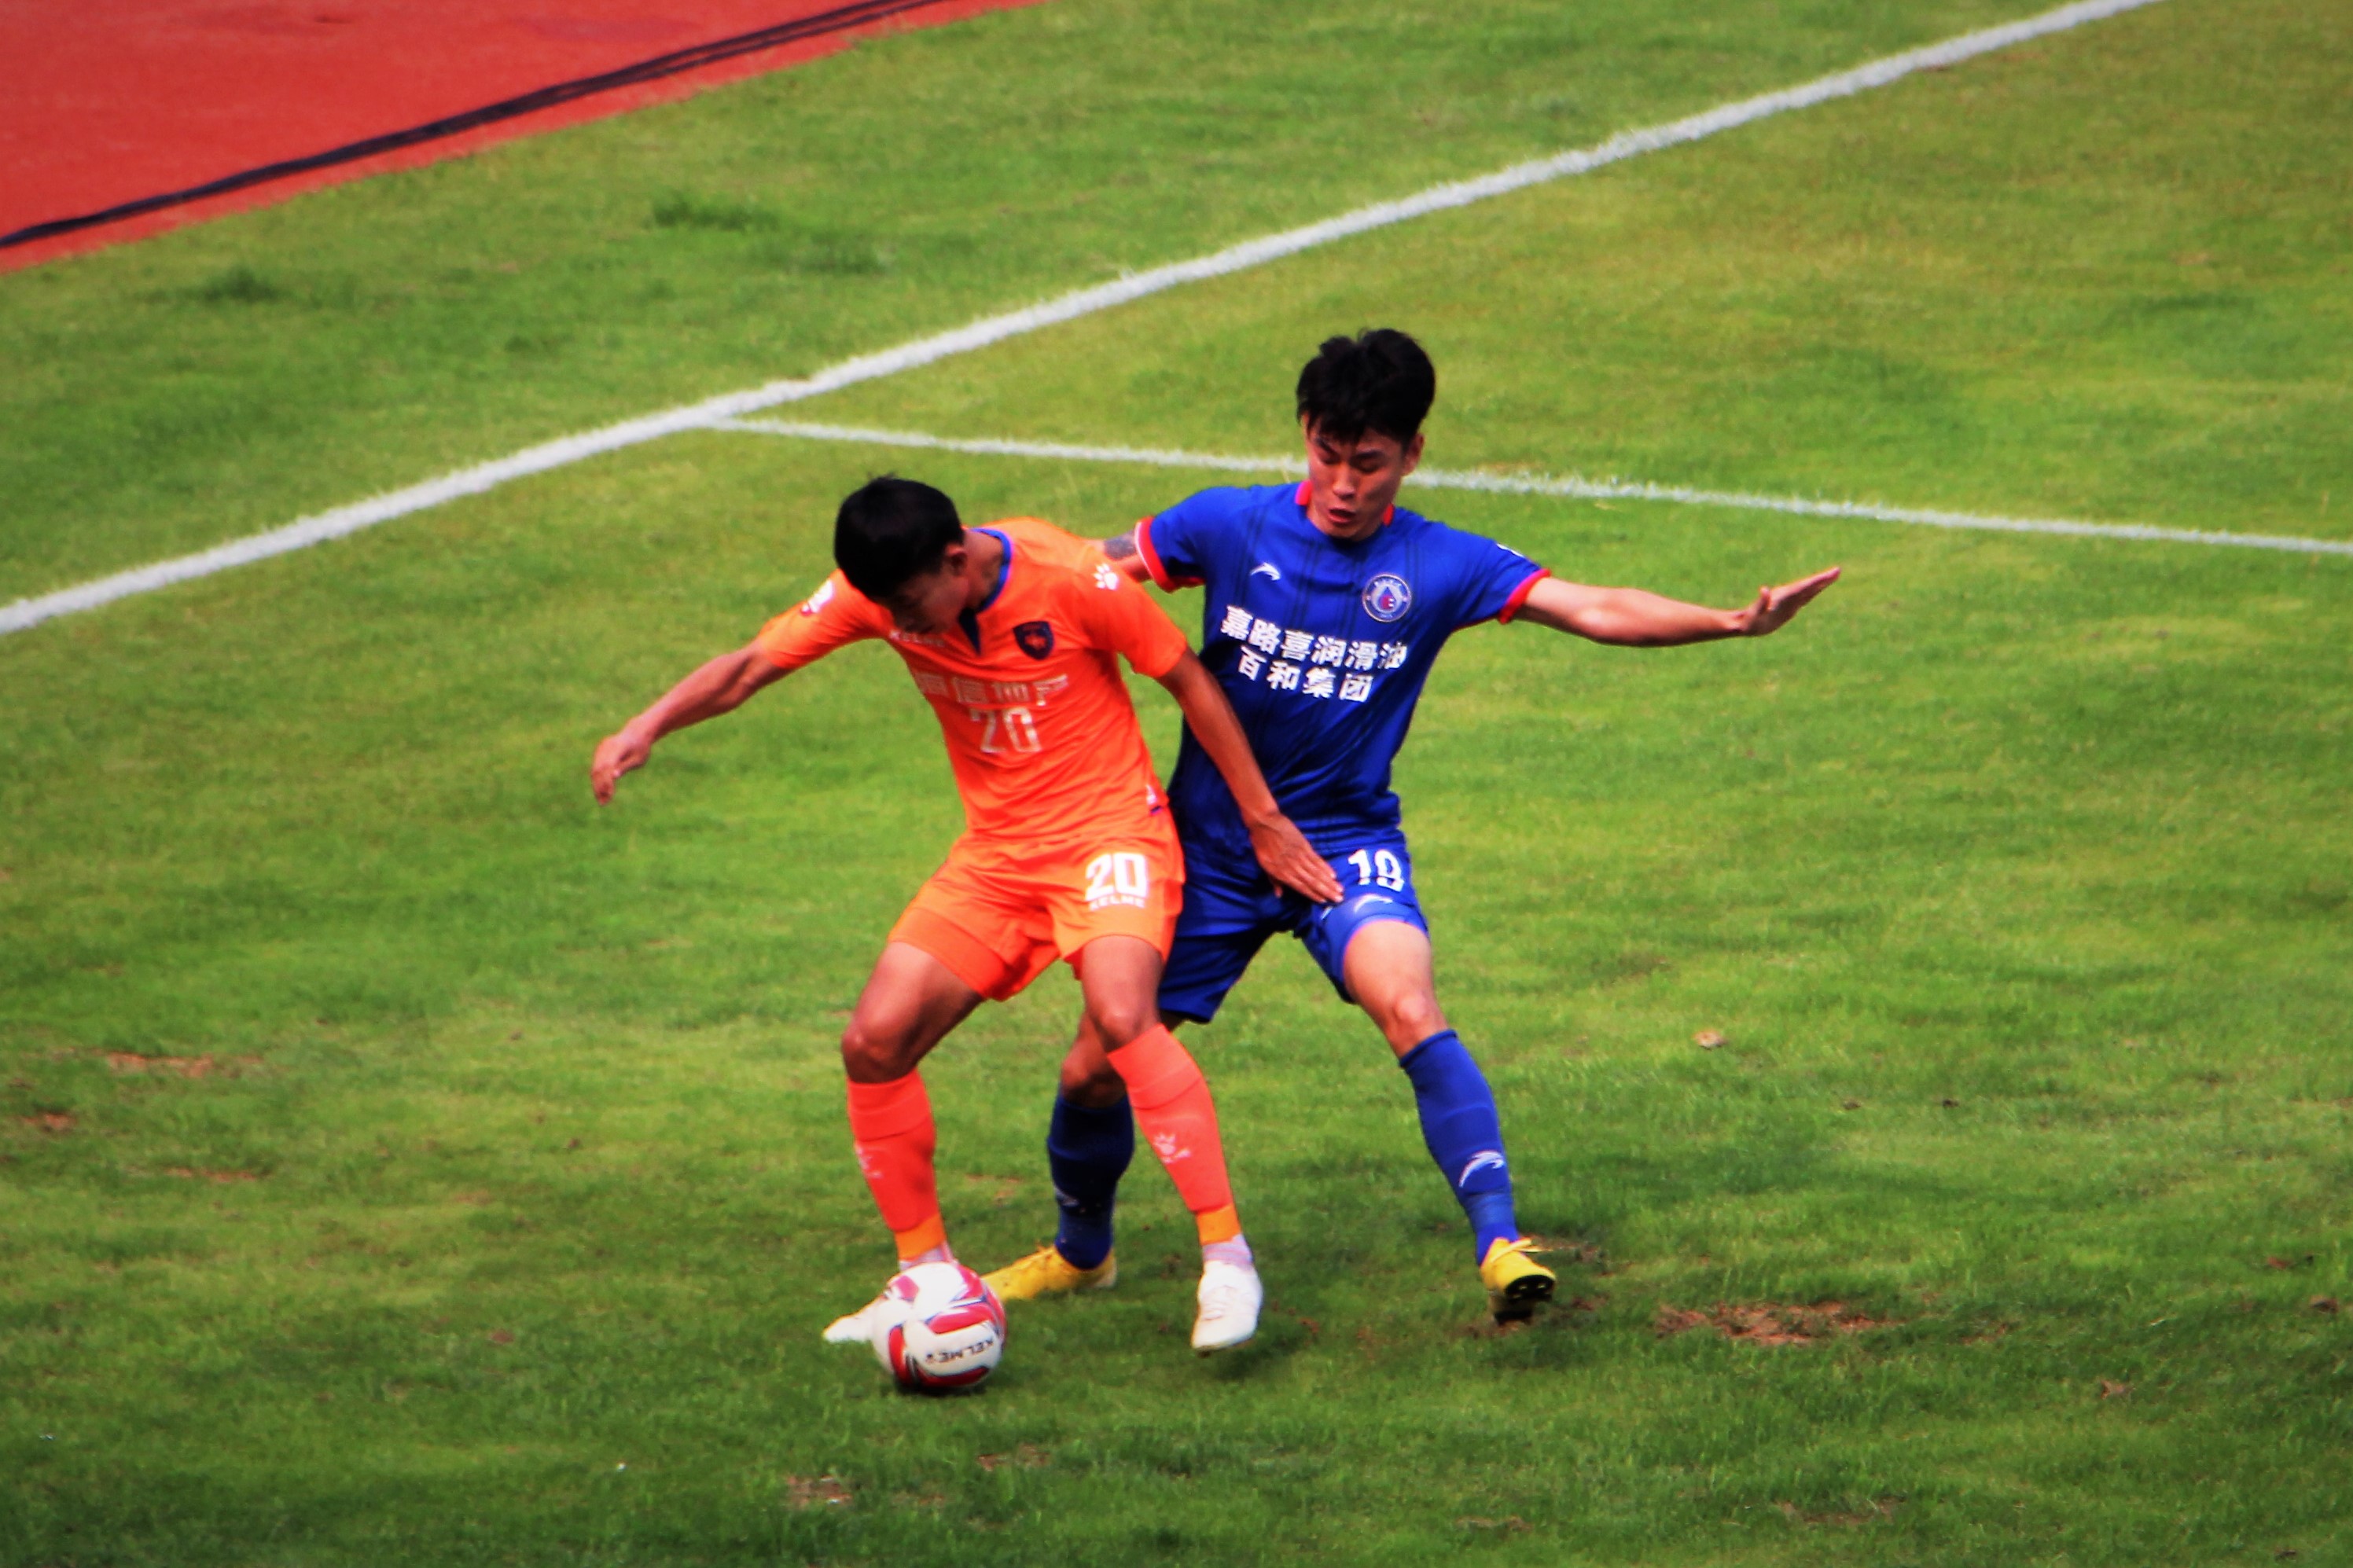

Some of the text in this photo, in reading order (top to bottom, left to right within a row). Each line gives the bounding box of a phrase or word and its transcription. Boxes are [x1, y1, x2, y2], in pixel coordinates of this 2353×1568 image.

[1220, 604, 1407, 669] 嘉路喜润滑油
[1238, 645, 1373, 702] 百和集团
[969, 707, 1042, 753] 20
[1085, 853, 1148, 902] 20
[1347, 849, 1405, 892] 19
[1089, 895, 1145, 912] KELME
[939, 1338, 994, 1363] KELME
